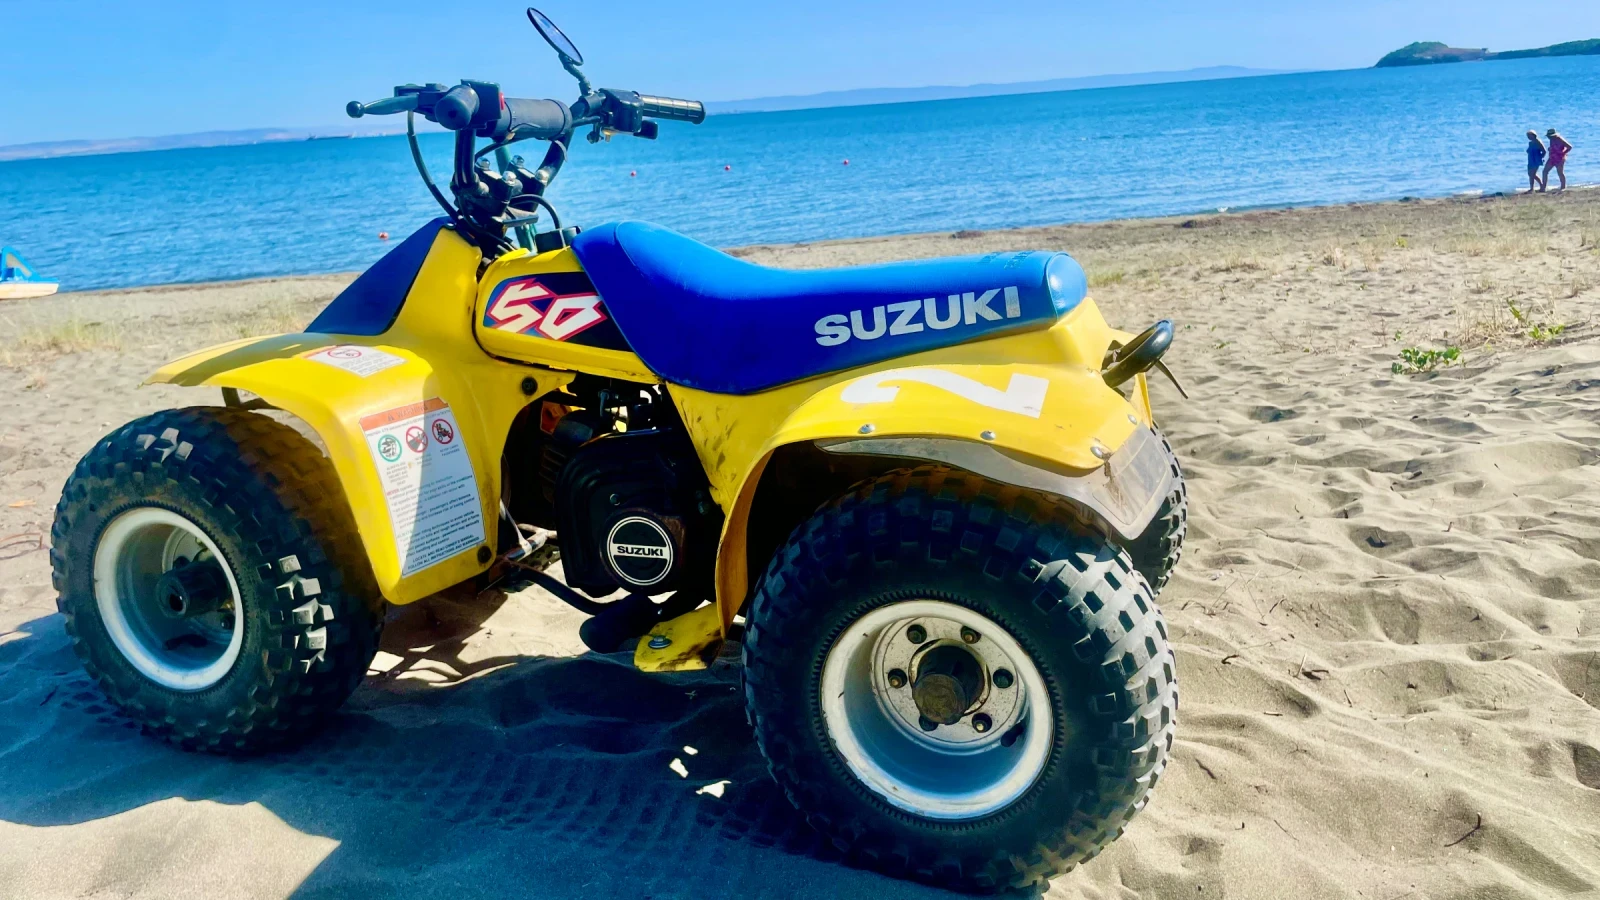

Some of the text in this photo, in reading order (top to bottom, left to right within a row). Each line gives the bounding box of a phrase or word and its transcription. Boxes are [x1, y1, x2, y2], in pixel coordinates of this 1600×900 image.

[488, 279, 605, 341] 50
[814, 285, 1021, 347] SUZUKI
[840, 368, 1050, 419] 2
[617, 545, 664, 557] SUZUKI
